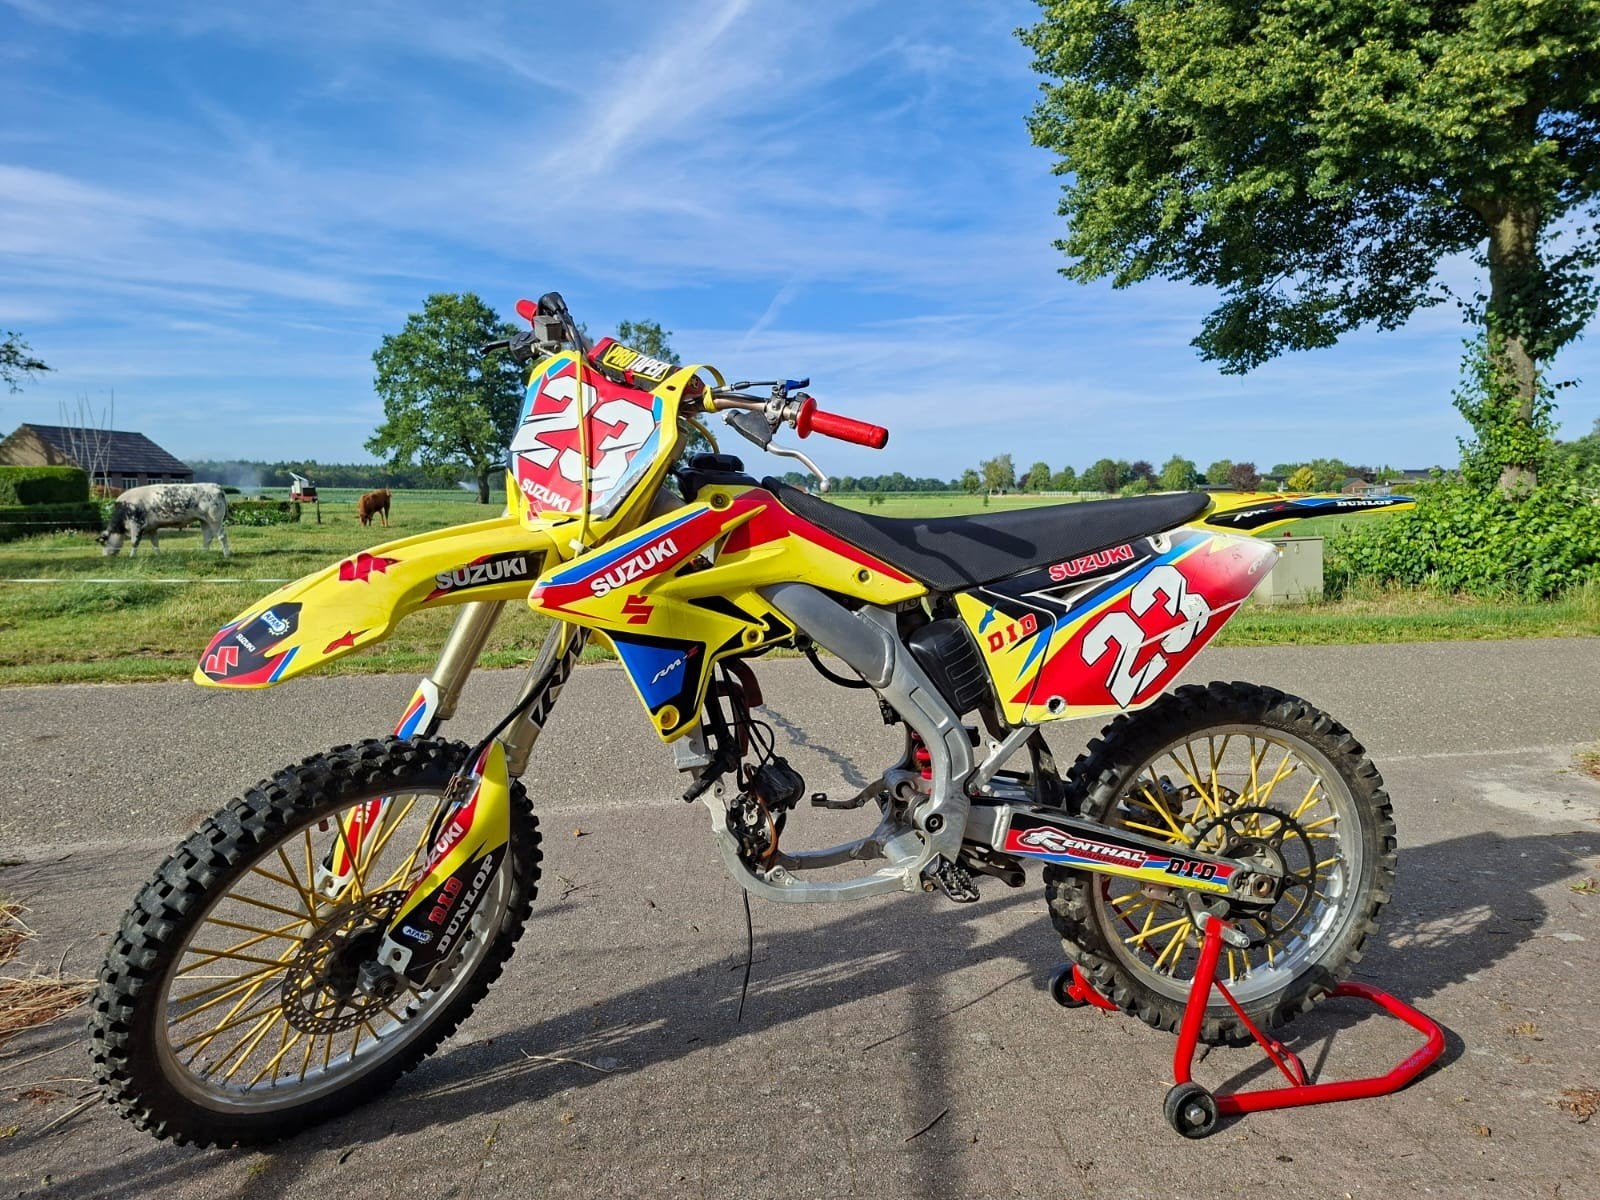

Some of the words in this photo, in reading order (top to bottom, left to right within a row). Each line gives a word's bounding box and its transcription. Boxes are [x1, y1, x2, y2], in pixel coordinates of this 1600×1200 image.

[510, 375, 656, 492] 23
[521, 479, 571, 512] SUZUKI
[435, 556, 527, 590] SUZUKI
[590, 537, 679, 598] SUZUKI
[1049, 544, 1134, 581] SUZUKI
[235, 633, 256, 653] SUZUKI
[1080, 564, 1212, 709] 23
[410, 821, 464, 881] SUZUKI
[1024, 830, 1144, 862] RENTHAL
[436, 854, 494, 954] DUNLOP
[404, 926, 430, 942] AFAM
